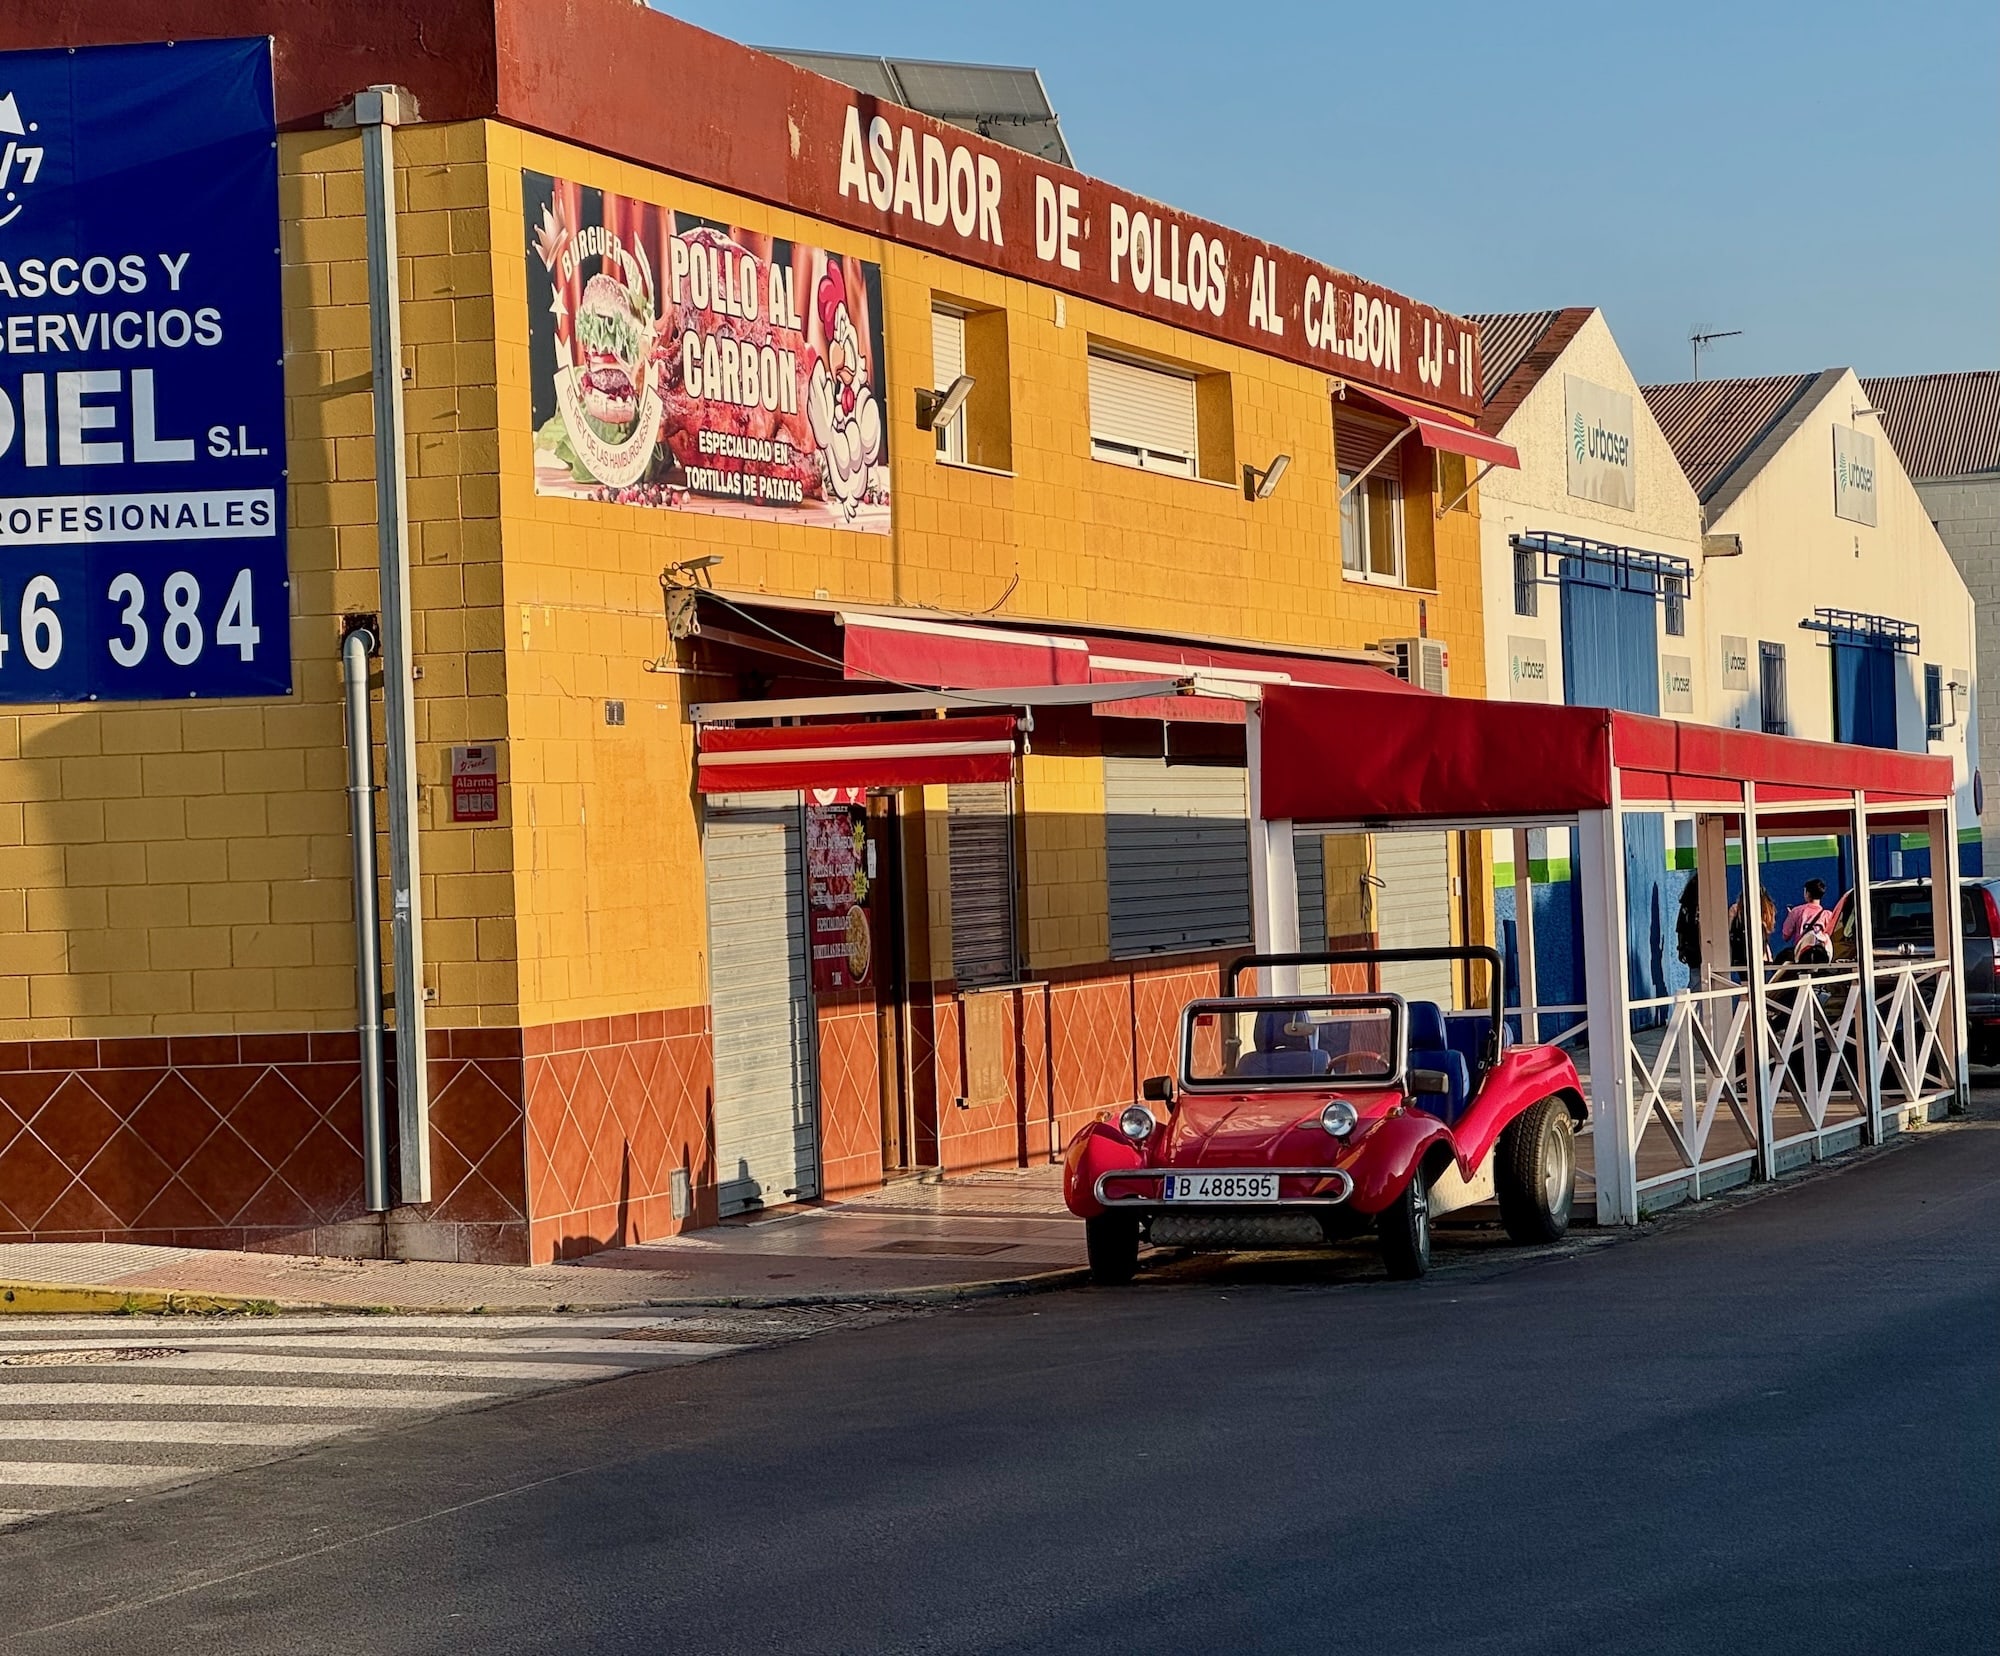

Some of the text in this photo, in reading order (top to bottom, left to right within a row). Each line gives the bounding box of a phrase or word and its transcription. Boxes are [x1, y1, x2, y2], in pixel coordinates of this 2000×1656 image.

[839, 105, 1004, 246] ASADOR
[1035, 174, 1081, 271] DE
[1110, 203, 1226, 317] POLLOS
[1249, 255, 1284, 336] AL
[158, 253, 190, 291] Y
[562, 226, 622, 283] BURGUER
[670, 235, 802, 331] POLLO AL
[0, 307, 223, 354] ERVICIOS
[682, 330, 798, 416] CARBÓN
[0, 368, 268, 467] IEL S.L.
[597, 447, 609, 467] LAS
[698, 430, 789, 465] ESPECIALIDAD EN
[1588, 418, 1628, 467] urbaser
[685, 466, 803, 503] TORTILLAS DE PATATAS
[1849, 456, 1873, 493] urbaser
[0, 499, 271, 534] OFESIONALES
[0, 568, 260, 670] 6 384
[1521, 655, 1544, 679] urbaser
[456, 777, 494, 788] Alarma
[1180, 1178, 1272, 1197] B 488595
